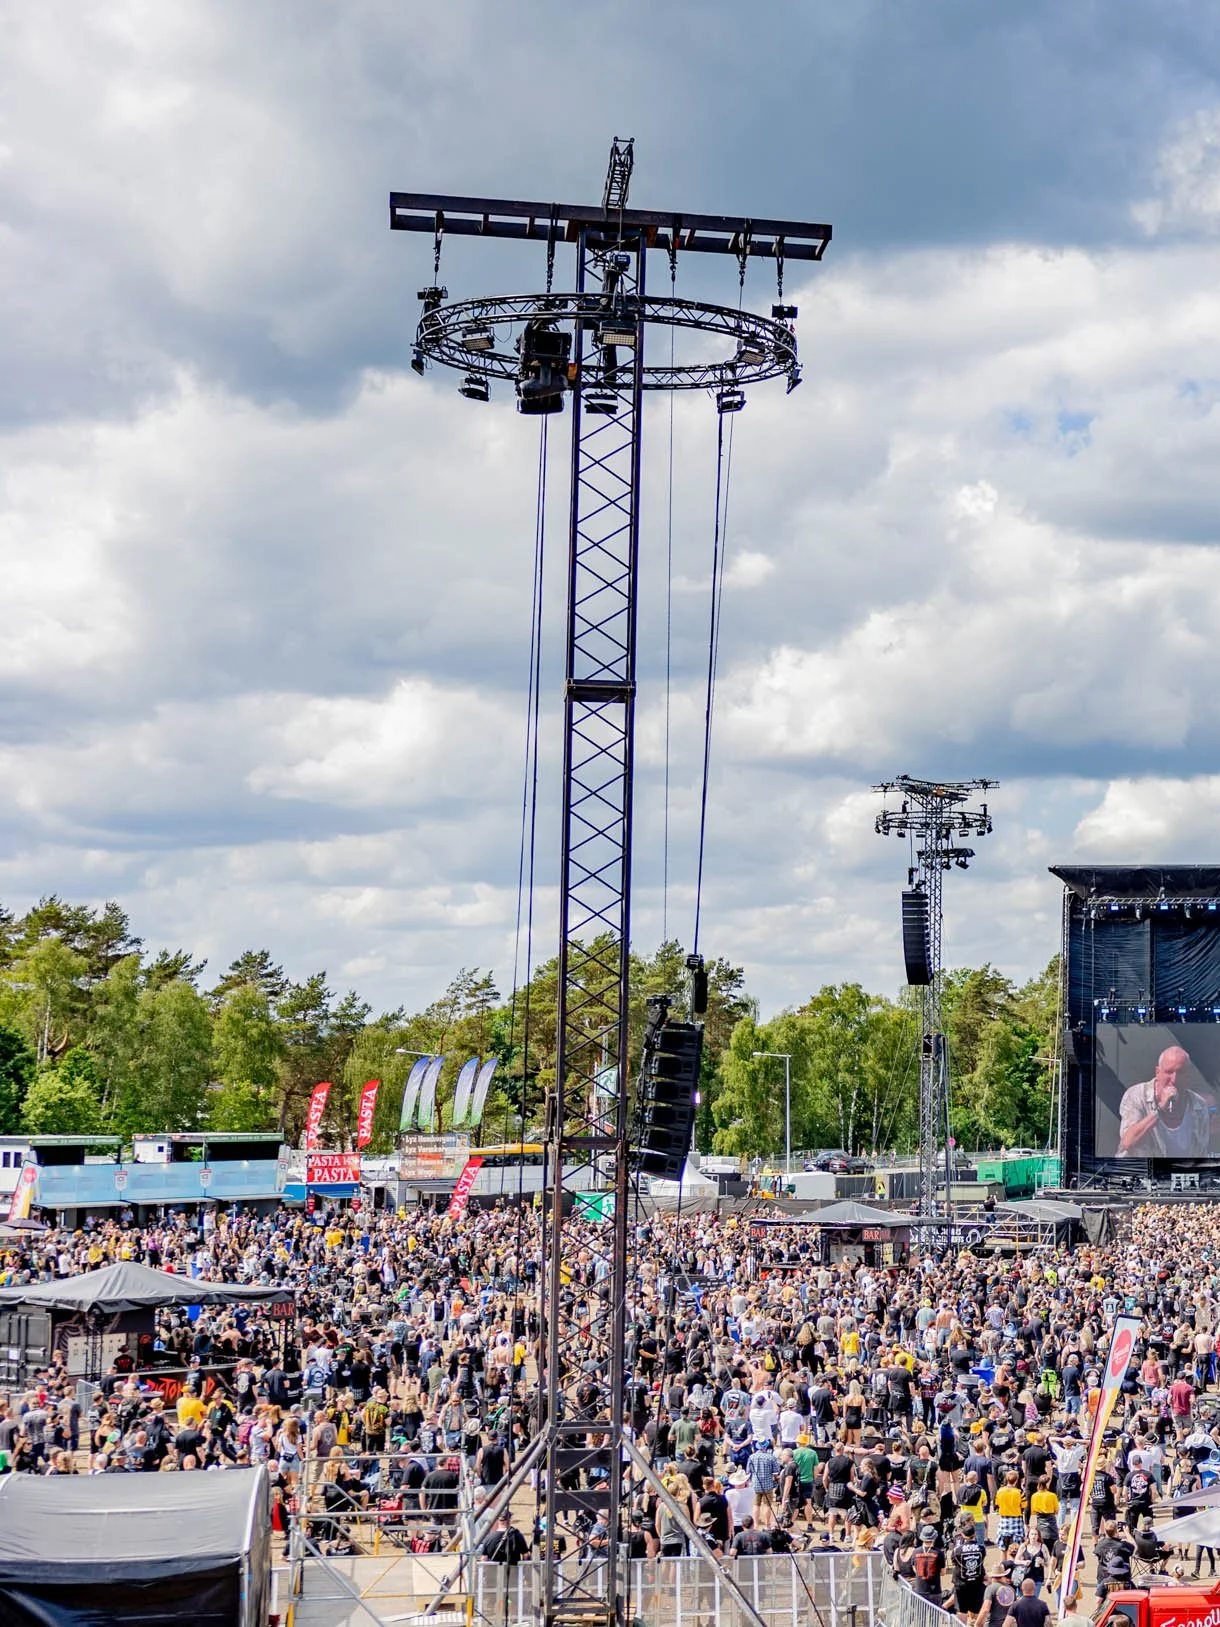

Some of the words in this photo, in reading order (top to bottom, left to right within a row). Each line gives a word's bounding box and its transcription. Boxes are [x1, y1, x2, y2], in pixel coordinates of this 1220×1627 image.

[307, 1090, 328, 1141] PASTA
[359, 1088, 377, 1139] PASTA
[309, 1155, 340, 1167] PASTA
[314, 1168, 355, 1182] PASTA
[452, 1165, 479, 1213] PASTA
[751, 1228, 766, 1237] BAR
[863, 1229, 880, 1240] BAR
[273, 1302, 294, 1316] BAR
